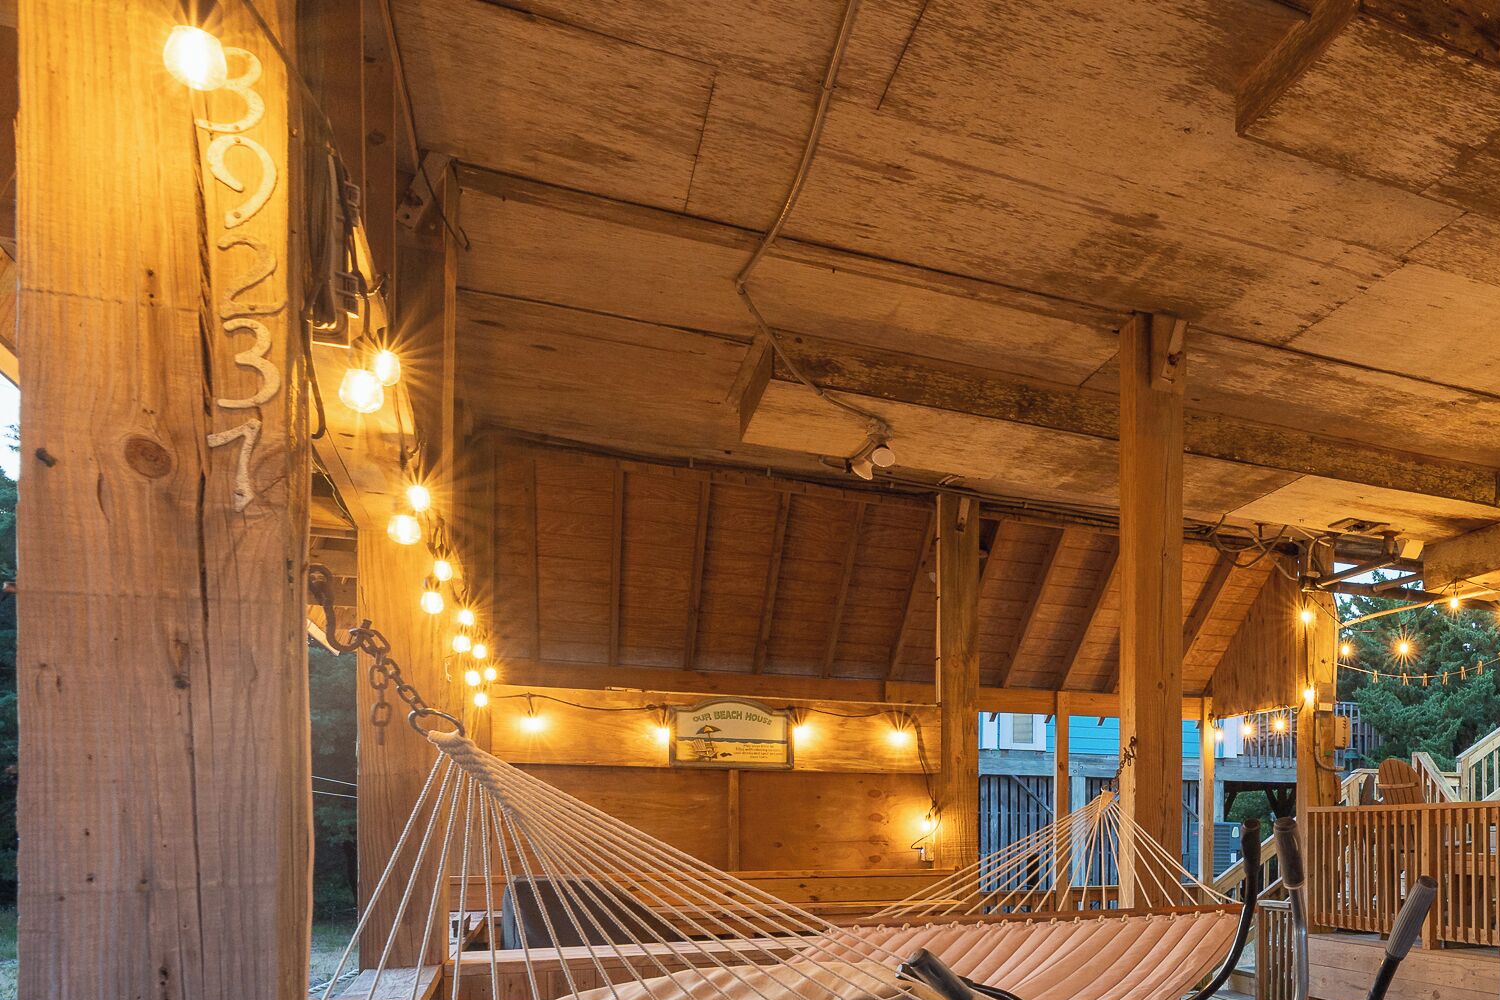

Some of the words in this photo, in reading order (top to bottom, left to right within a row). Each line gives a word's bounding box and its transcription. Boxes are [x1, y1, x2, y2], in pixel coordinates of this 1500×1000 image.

[194, 46, 286, 513] 39237
[693, 712, 712, 722] OUR
[713, 710, 743, 720] BEACH
[745, 711, 773, 725] HOUSE
